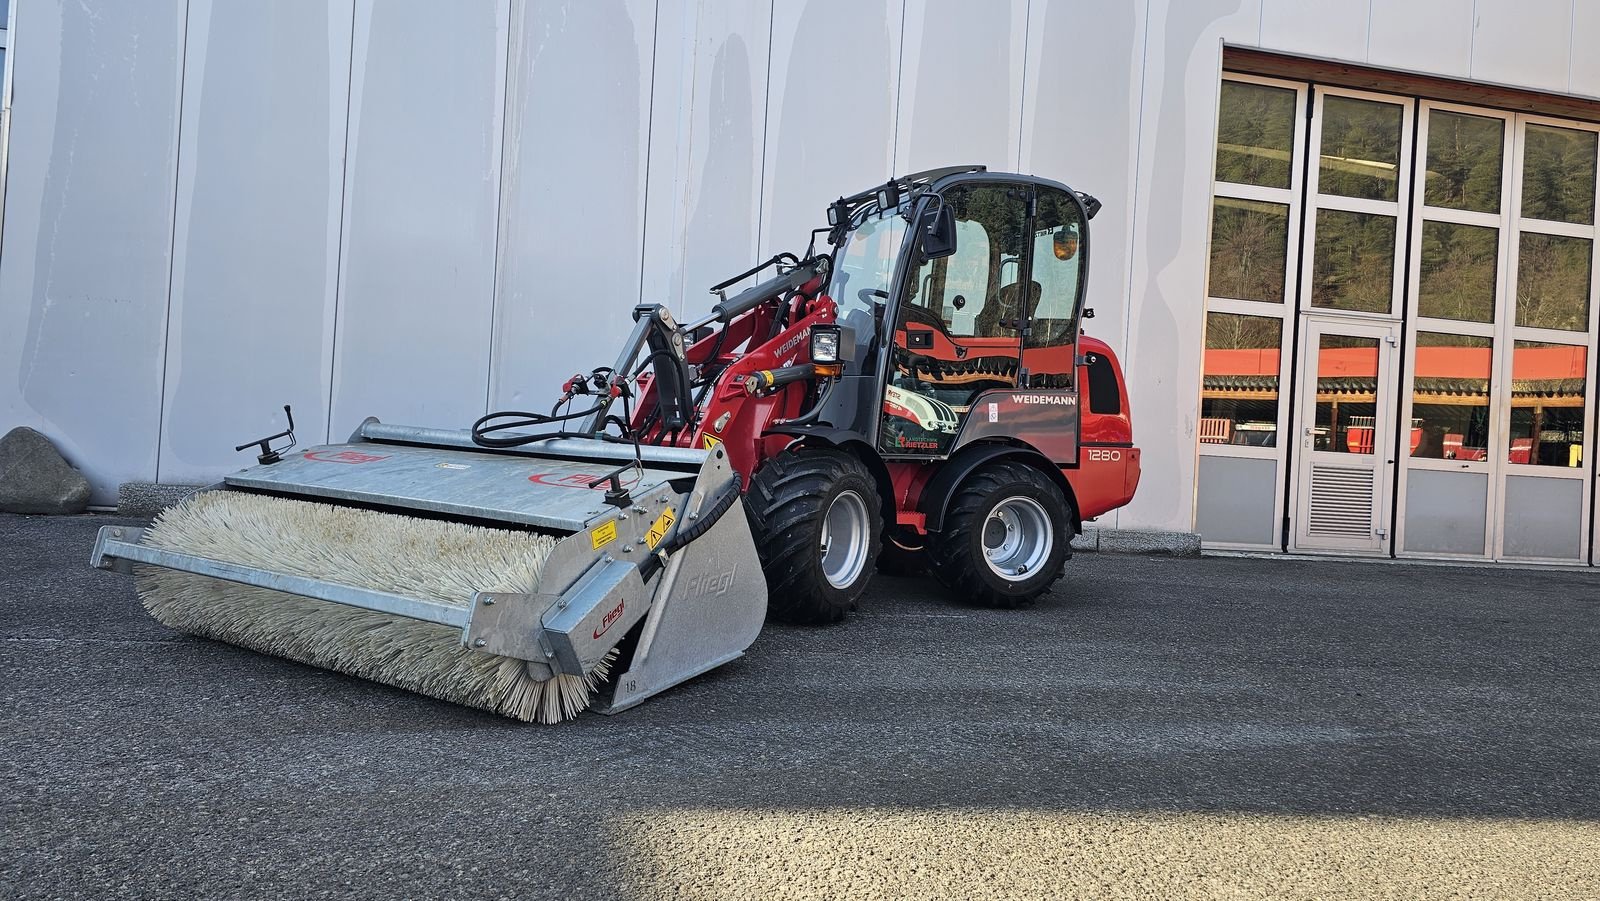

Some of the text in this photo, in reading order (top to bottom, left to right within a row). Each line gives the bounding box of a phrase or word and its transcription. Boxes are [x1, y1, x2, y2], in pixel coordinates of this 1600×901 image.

[773, 321, 817, 359] WEIDEMAN
[1012, 394, 1076, 406] WEIDEMANN
[905, 441, 939, 449] RIETZLER
[1088, 449, 1121, 461] 1280
[683, 562, 738, 600] Fliegl
[602, 597, 625, 628] Fliegl
[625, 679, 637, 693] 18
